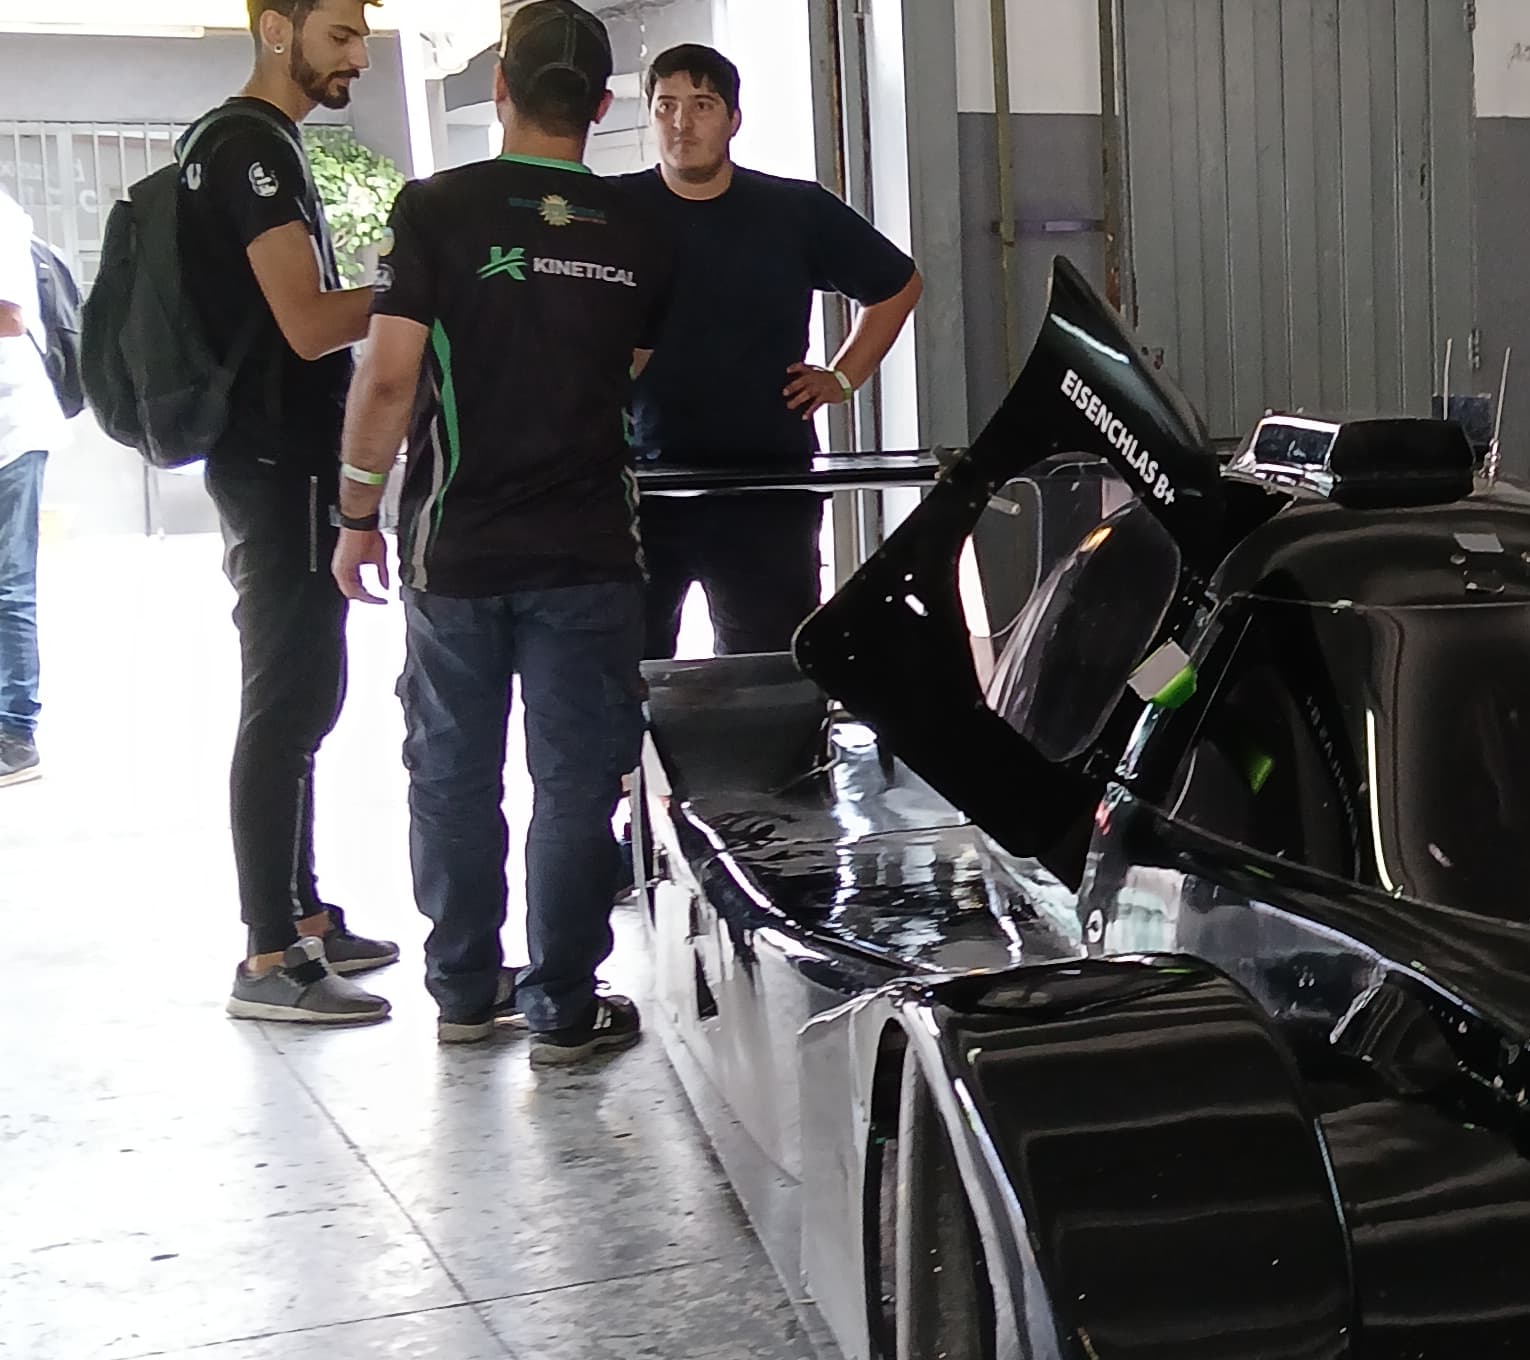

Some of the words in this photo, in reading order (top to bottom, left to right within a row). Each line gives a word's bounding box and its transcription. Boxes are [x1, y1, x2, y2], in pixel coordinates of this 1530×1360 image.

[533, 257, 638, 288] KINETICAL
[1060, 368, 1159, 484] EISENCHLAS
[1152, 472, 1176, 506] B+
